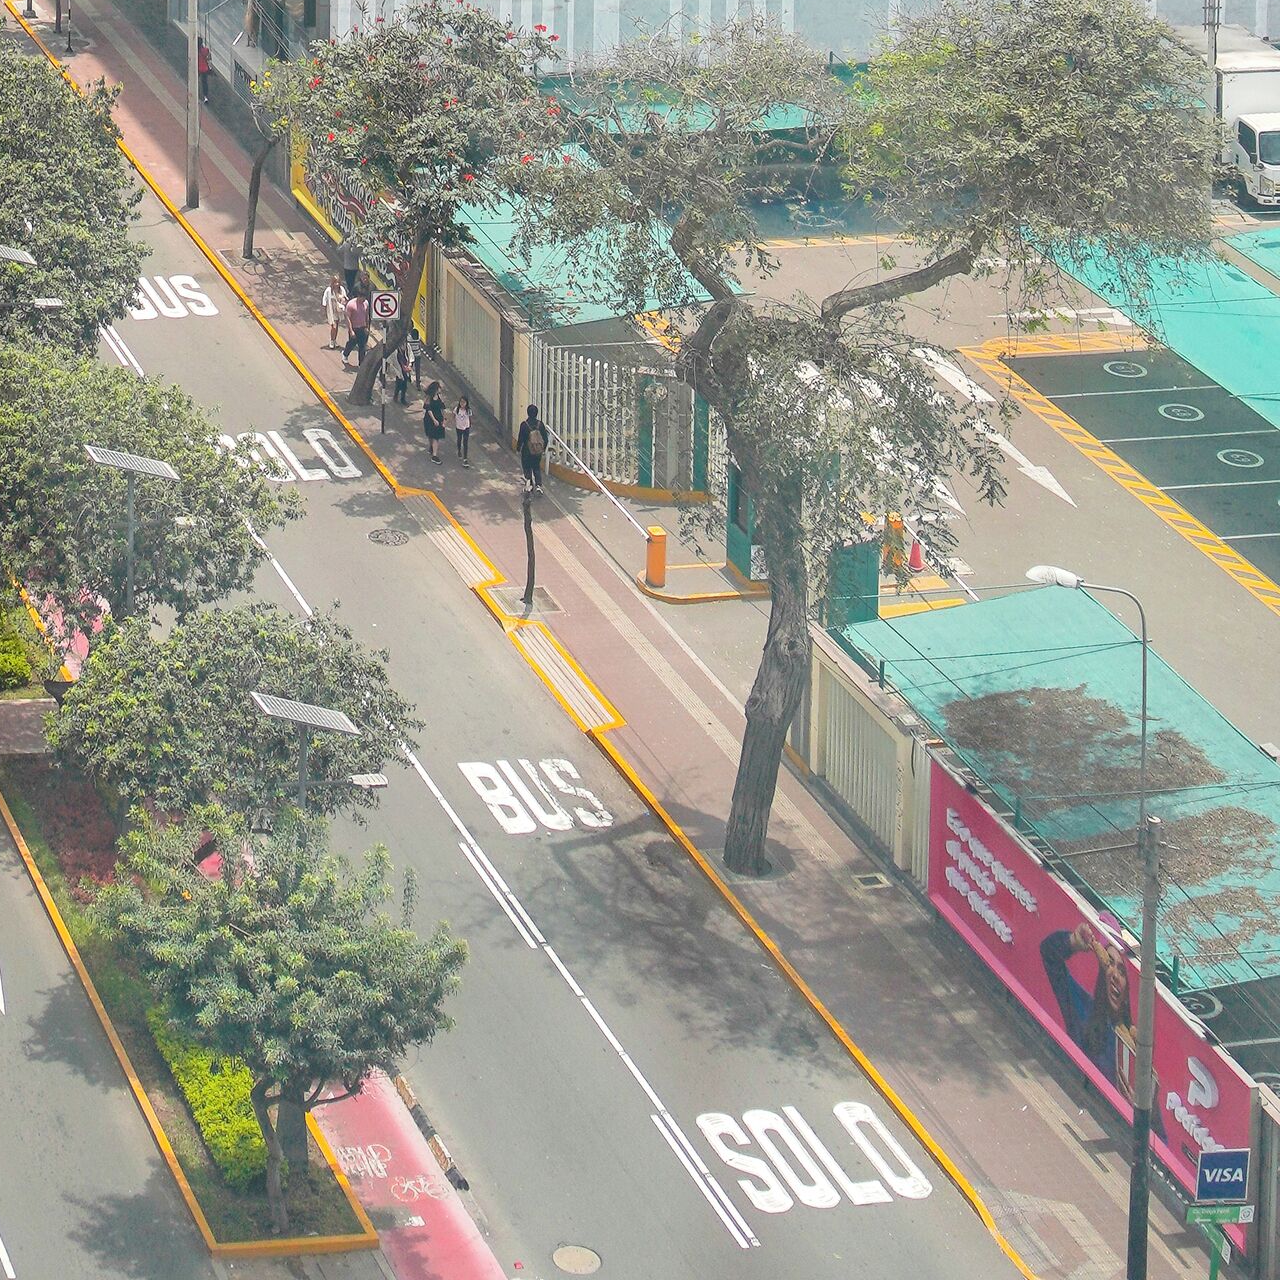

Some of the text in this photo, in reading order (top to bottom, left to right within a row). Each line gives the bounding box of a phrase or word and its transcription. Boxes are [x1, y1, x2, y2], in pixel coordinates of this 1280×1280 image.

[457, 757, 616, 835] BUS
[695, 1101, 934, 1214] SOLO
[1202, 1167, 1244, 1183] VISA
